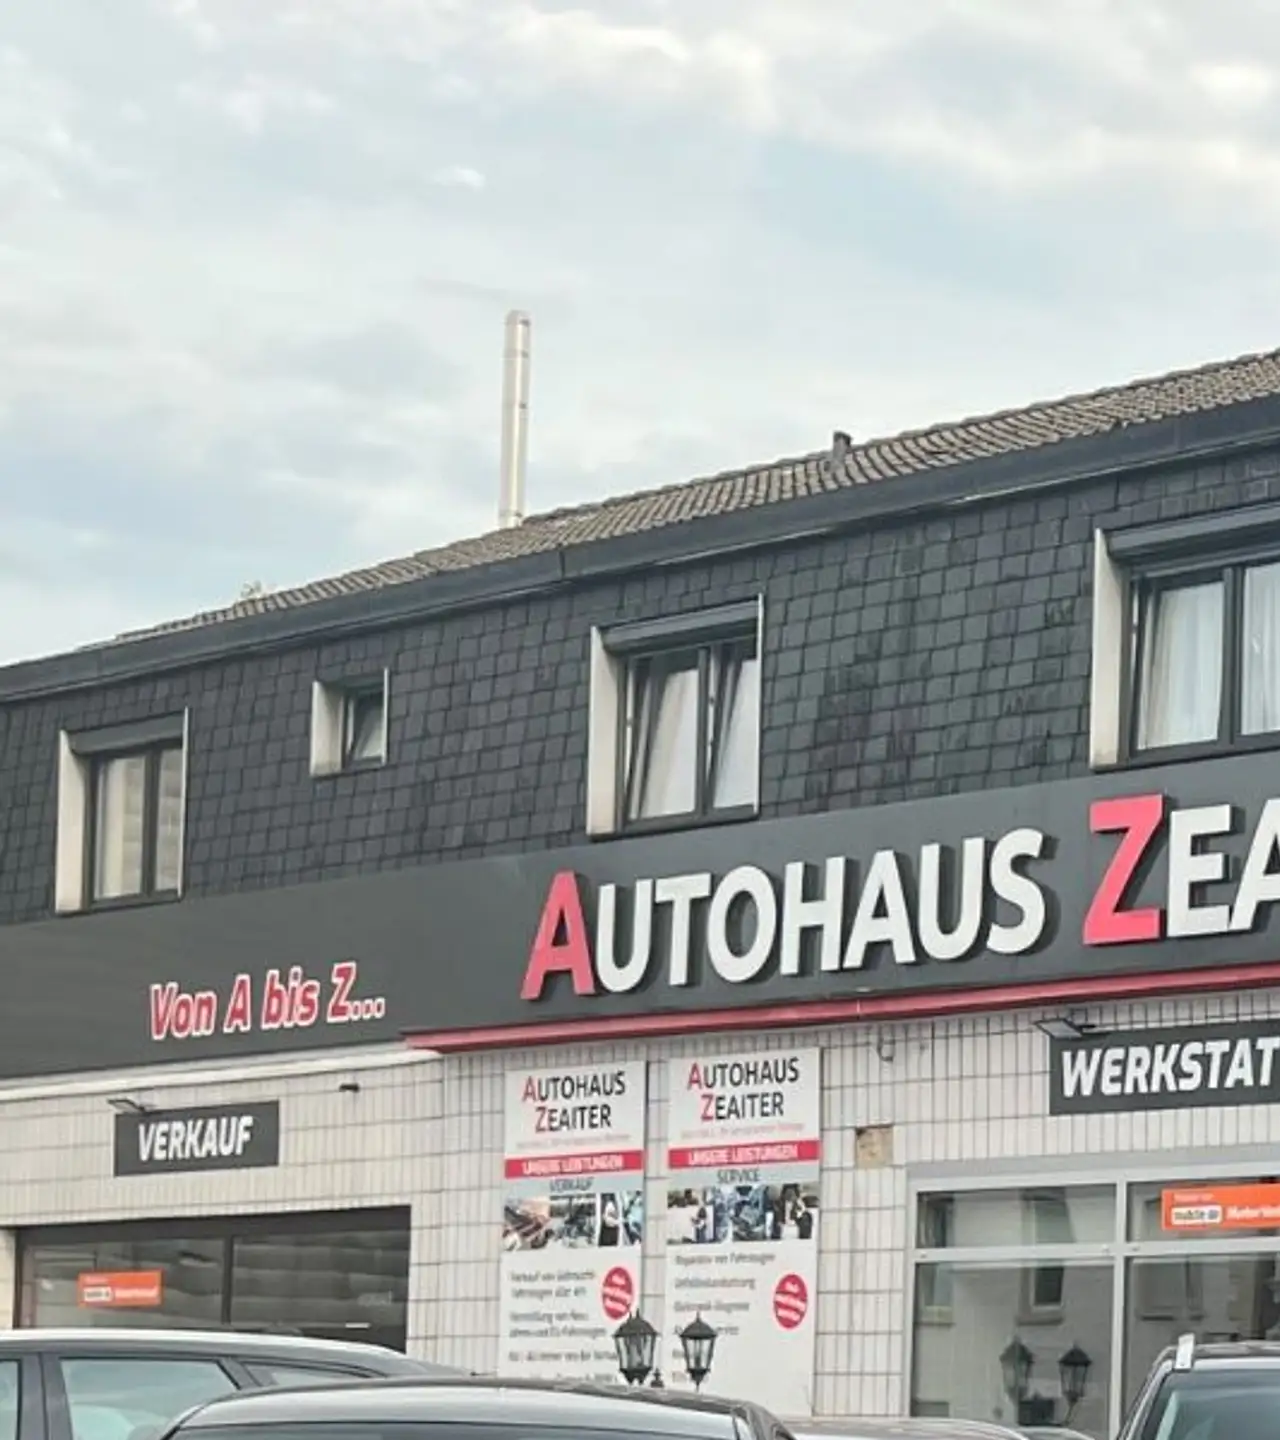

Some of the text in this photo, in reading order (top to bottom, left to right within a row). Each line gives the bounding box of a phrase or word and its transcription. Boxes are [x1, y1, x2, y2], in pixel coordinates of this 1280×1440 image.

[520, 826, 1047, 1001] AUTOHAUS
[150, 980, 218, 1040] Von
[222, 973, 253, 1034] A
[260, 964, 321, 1031] bis
[522, 1069, 626, 1102] AUTOHAUS
[686, 1056, 800, 1090] AUTOHAUS
[534, 1103, 612, 1133] ZEAITER
[700, 1091, 785, 1122] ZEAITER
[137, 1114, 254, 1162] VERKAUF
[717, 1168, 760, 1184] SERVICE
